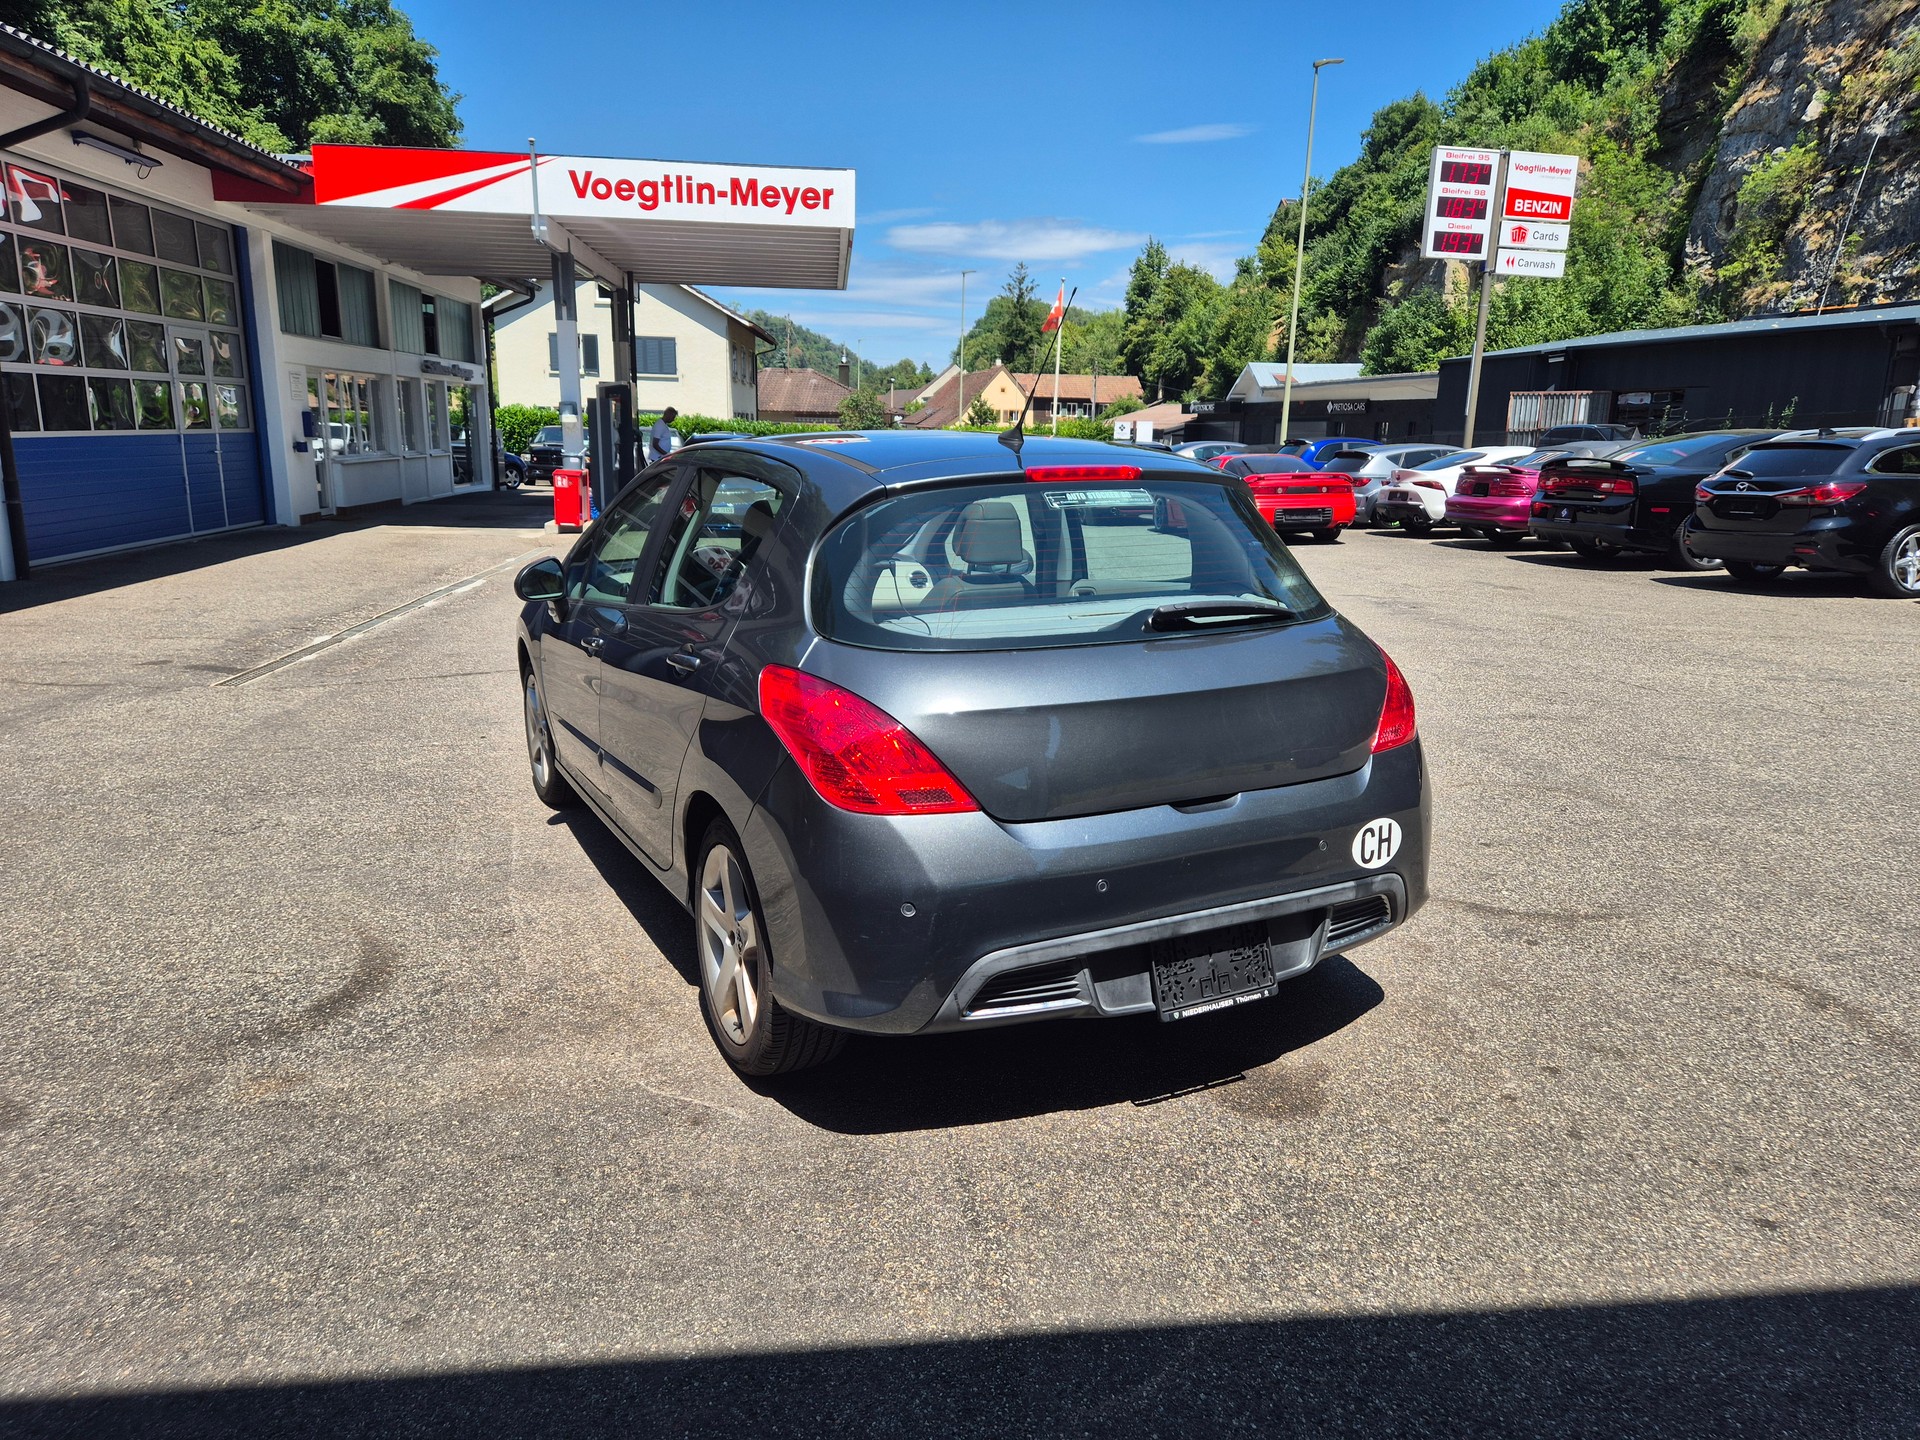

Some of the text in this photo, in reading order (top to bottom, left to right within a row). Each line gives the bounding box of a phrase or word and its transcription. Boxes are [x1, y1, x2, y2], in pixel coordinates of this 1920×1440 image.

[1446, 152, 1475, 160] Bleifrei
[1514, 163, 1572, 175] Voegtlin-Meyer
[568, 169, 834, 215] Voegtlin-Meyer
[1442, 187, 1471, 195] Bleifrei
[1514, 198, 1562, 215] BENZIN
[1447, 222, 1472, 230] Diesel
[1532, 230, 1560, 242] Cards
[1517, 258, 1556, 270] Carwash
[1360, 822, 1393, 865] CH
[1182, 998, 1234, 1018] NIEDERHAUSER
